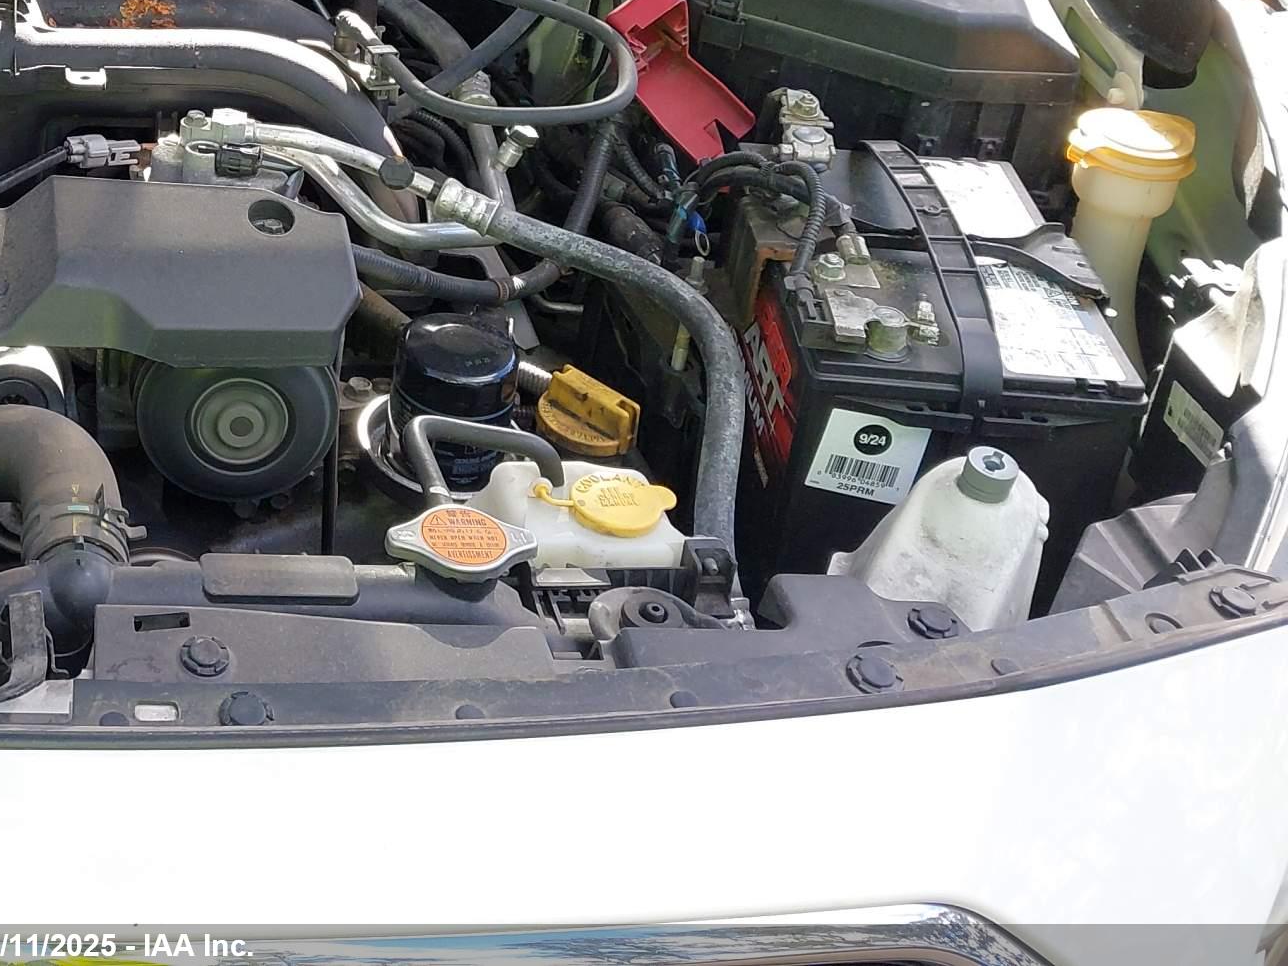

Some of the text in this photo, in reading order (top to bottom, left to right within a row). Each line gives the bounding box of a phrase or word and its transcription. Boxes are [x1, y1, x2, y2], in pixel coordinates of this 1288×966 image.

[744, 321, 786, 416] ART
[858, 433, 887, 446] 9/24
[836, 482, 875, 496] 25PRM
[447, 518, 487, 526] WARNING
